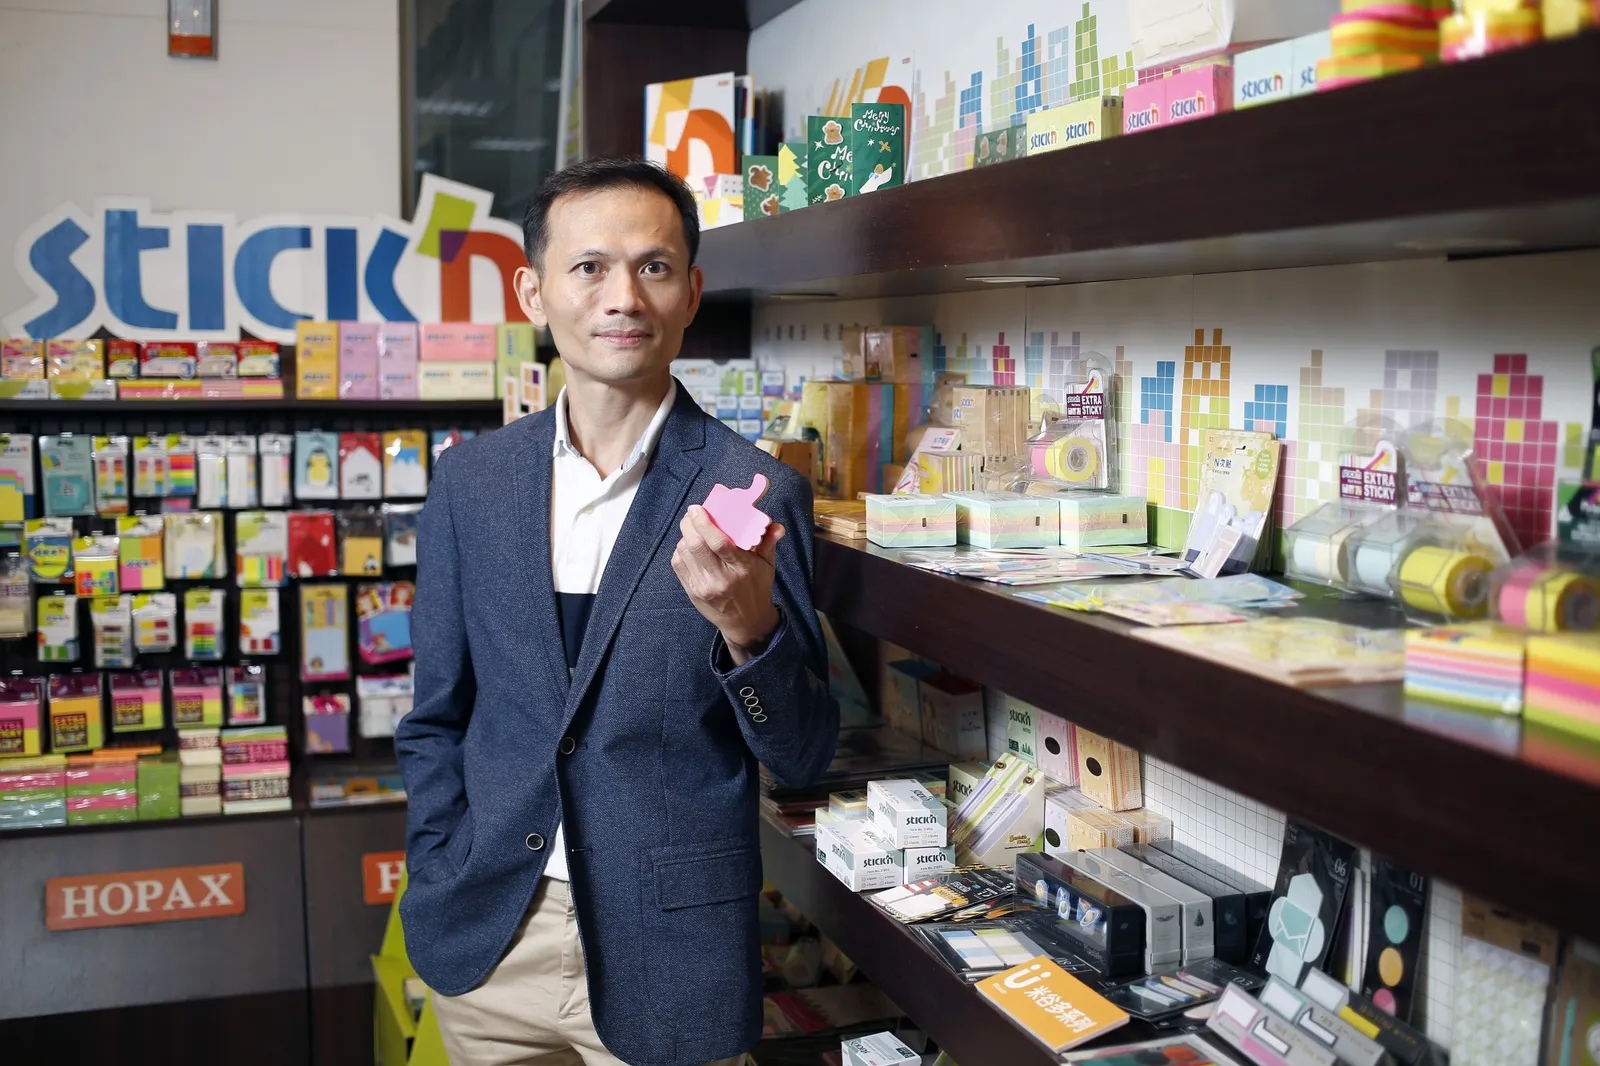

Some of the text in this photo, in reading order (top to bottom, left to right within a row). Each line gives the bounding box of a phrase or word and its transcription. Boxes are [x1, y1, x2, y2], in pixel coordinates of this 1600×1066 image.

[1082, 395, 1102, 405] EXTRA
[1082, 405, 1102, 415] STICKY
[1363, 471, 1396, 488] EXTRA
[1363, 486, 1396, 501] STICKY
[1334, 858, 1347, 877] 06
[61, 873, 234, 920] HOPAX
[1024, 985, 1098, 1033] 米谷多系列
